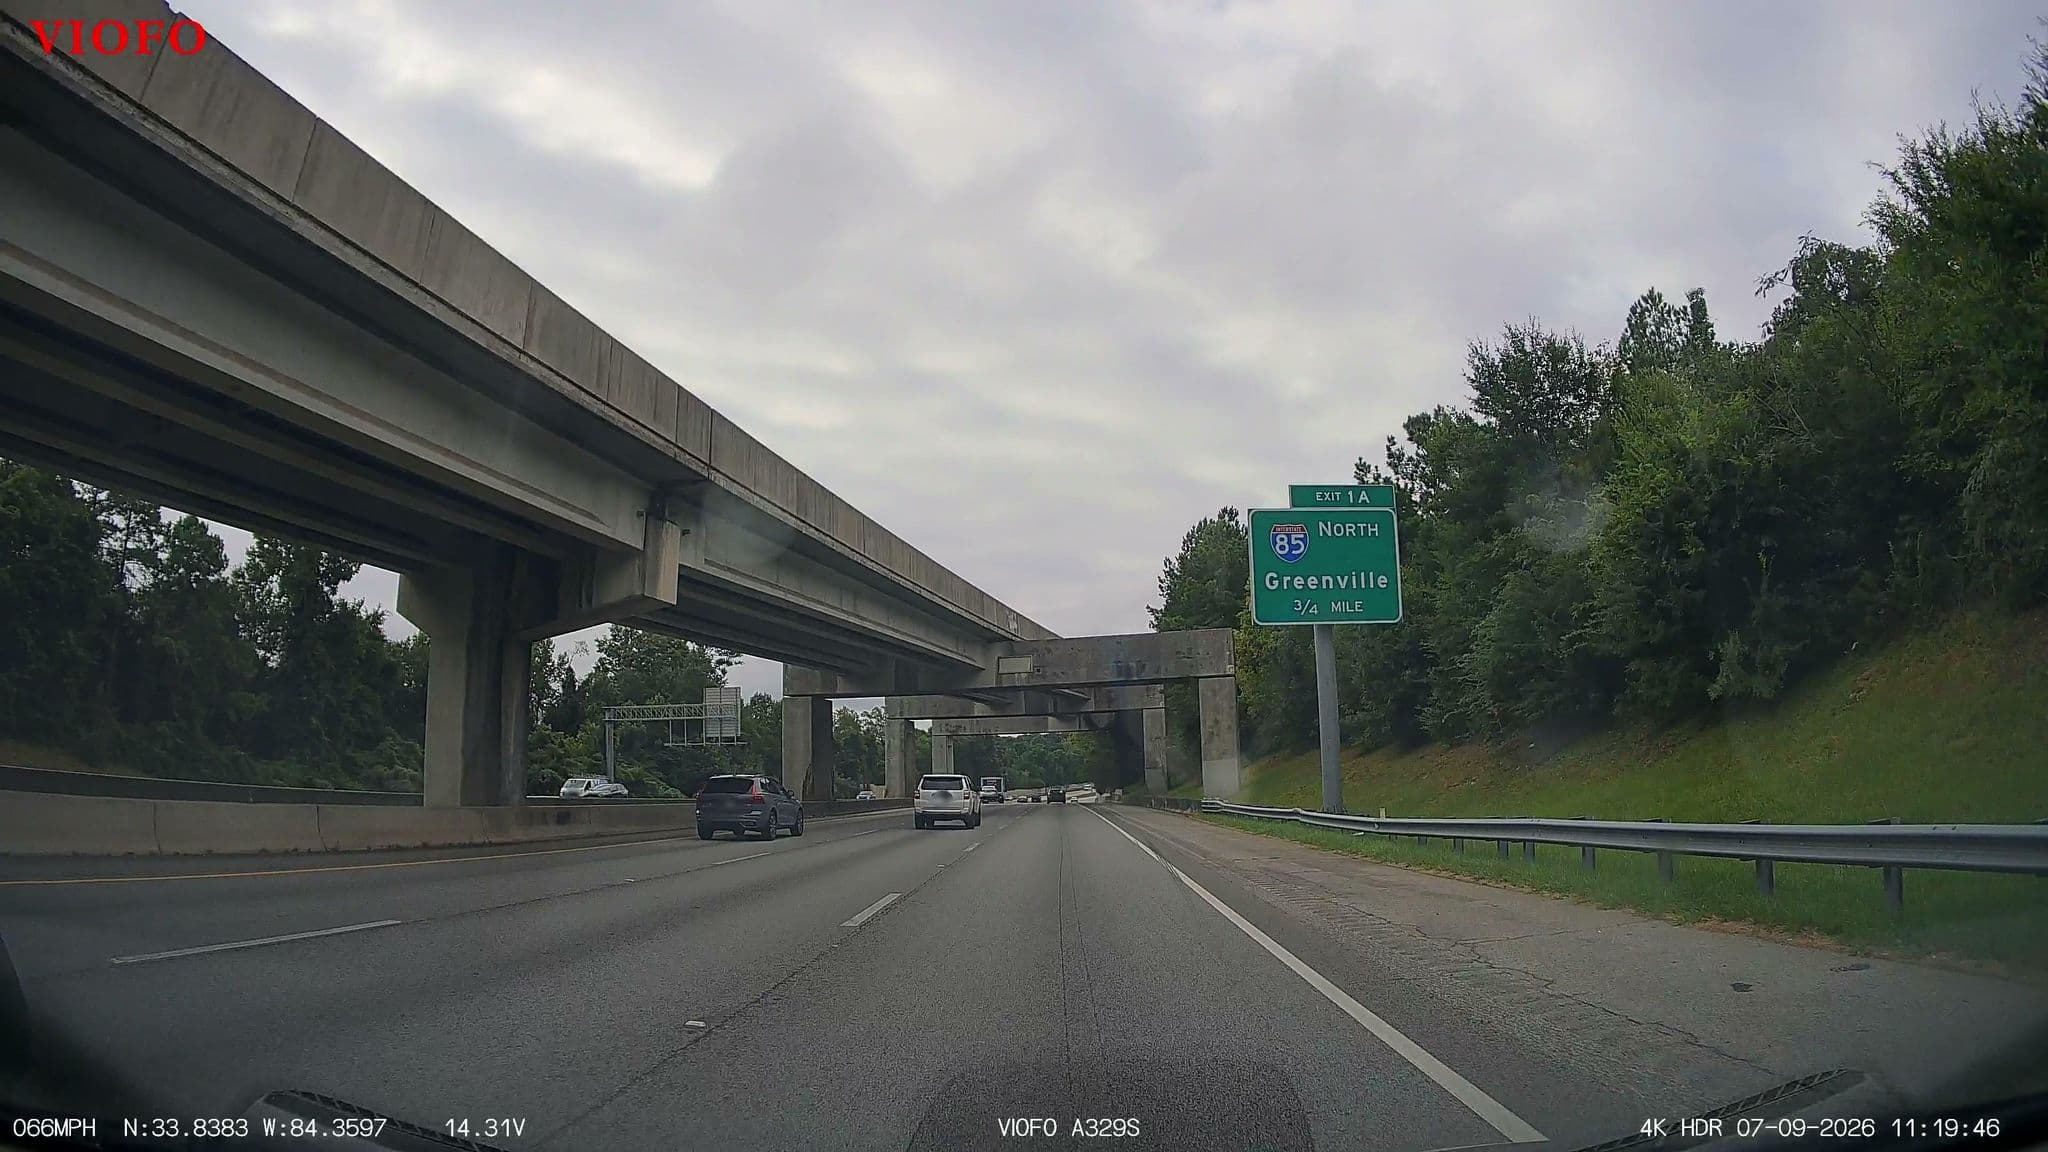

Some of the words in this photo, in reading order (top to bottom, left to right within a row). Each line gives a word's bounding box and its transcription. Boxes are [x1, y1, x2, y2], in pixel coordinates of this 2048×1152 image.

[1316, 491, 1341, 501] EXIT
[1348, 490, 1370, 504] 1A
[1318, 521, 1379, 537] NORTH
[1275, 533, 1305, 555] 85
[1265, 571, 1389, 590] Greenville
[1294, 599, 1319, 615] 3/4
[1331, 601, 1364, 612] MILE
